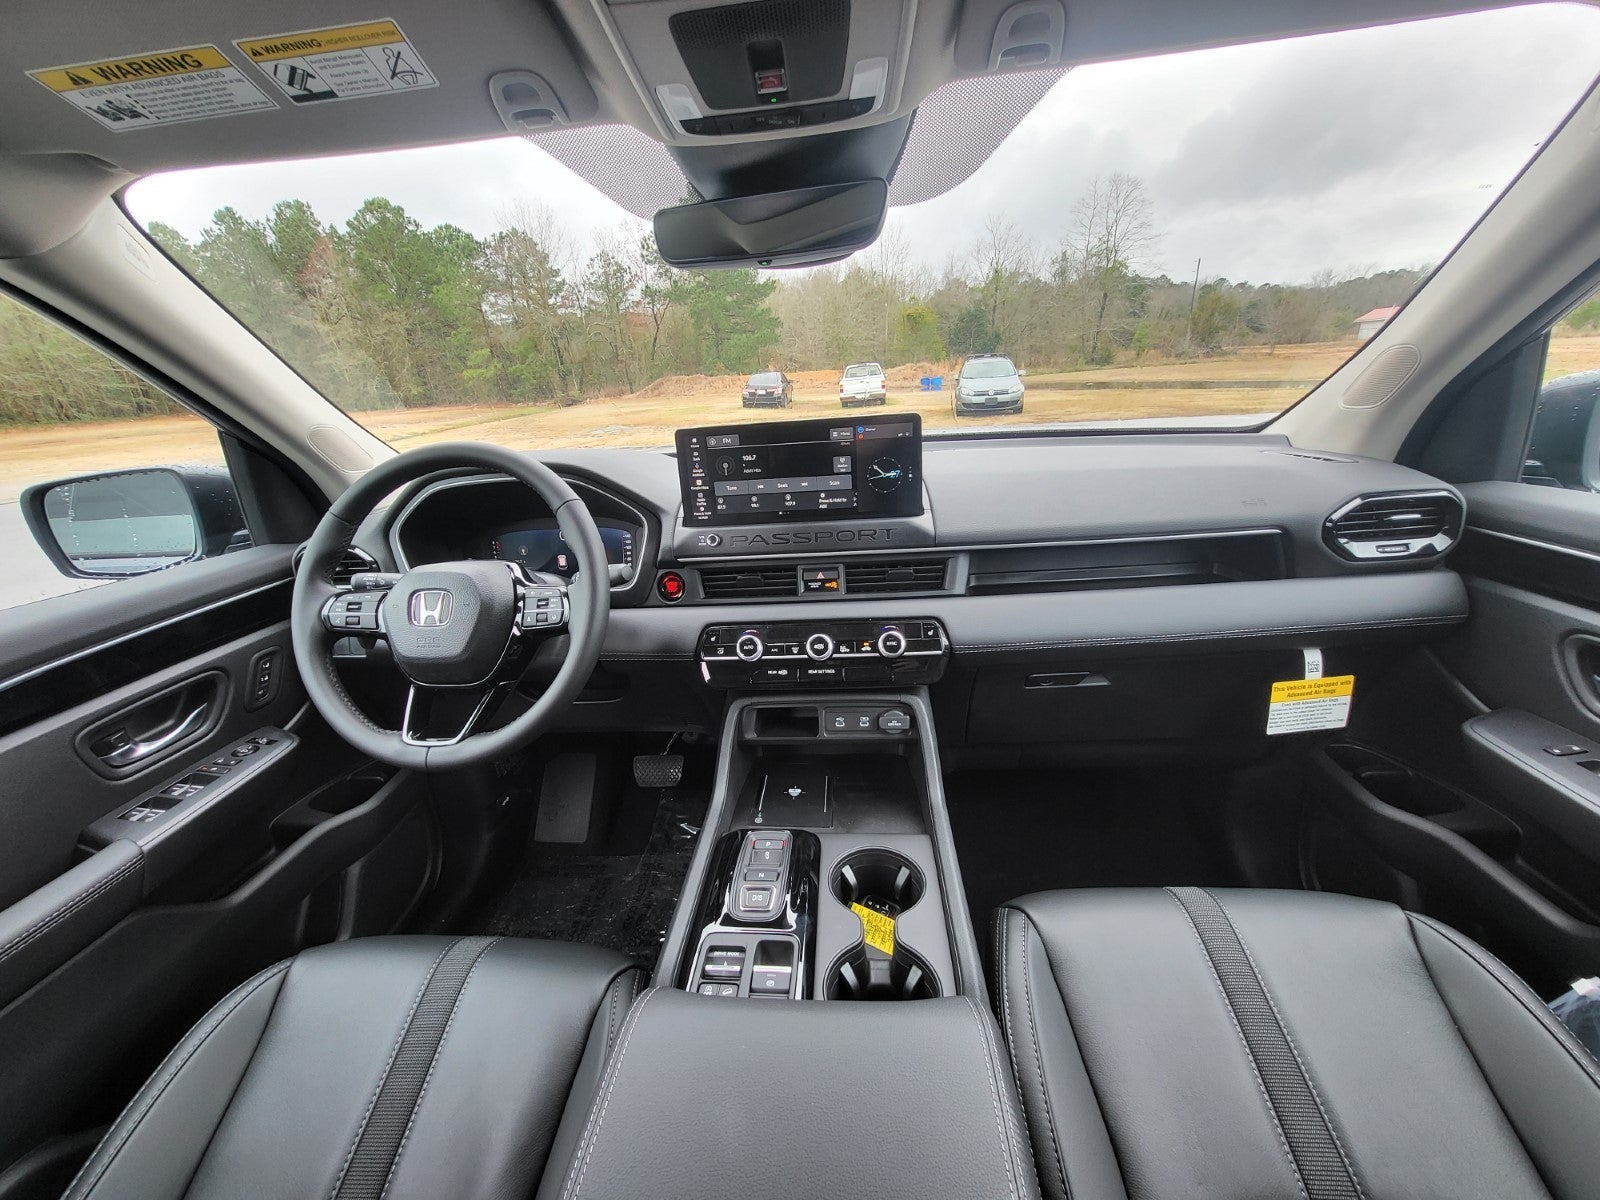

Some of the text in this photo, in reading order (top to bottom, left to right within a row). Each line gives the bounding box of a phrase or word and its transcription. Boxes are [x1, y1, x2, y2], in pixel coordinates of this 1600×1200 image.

[90, 53, 204, 82] WARNING
[104, 83, 131, 96] WITH
[130, 76, 182, 92] ADVANCED
[180, 74, 198, 85] AIR
[199, 70, 226, 82] BAGS
[730, 527, 895, 548] PASSPORT
[1287, 690, 1313, 698] Advanced
[1314, 681, 1339, 689] Equipped
